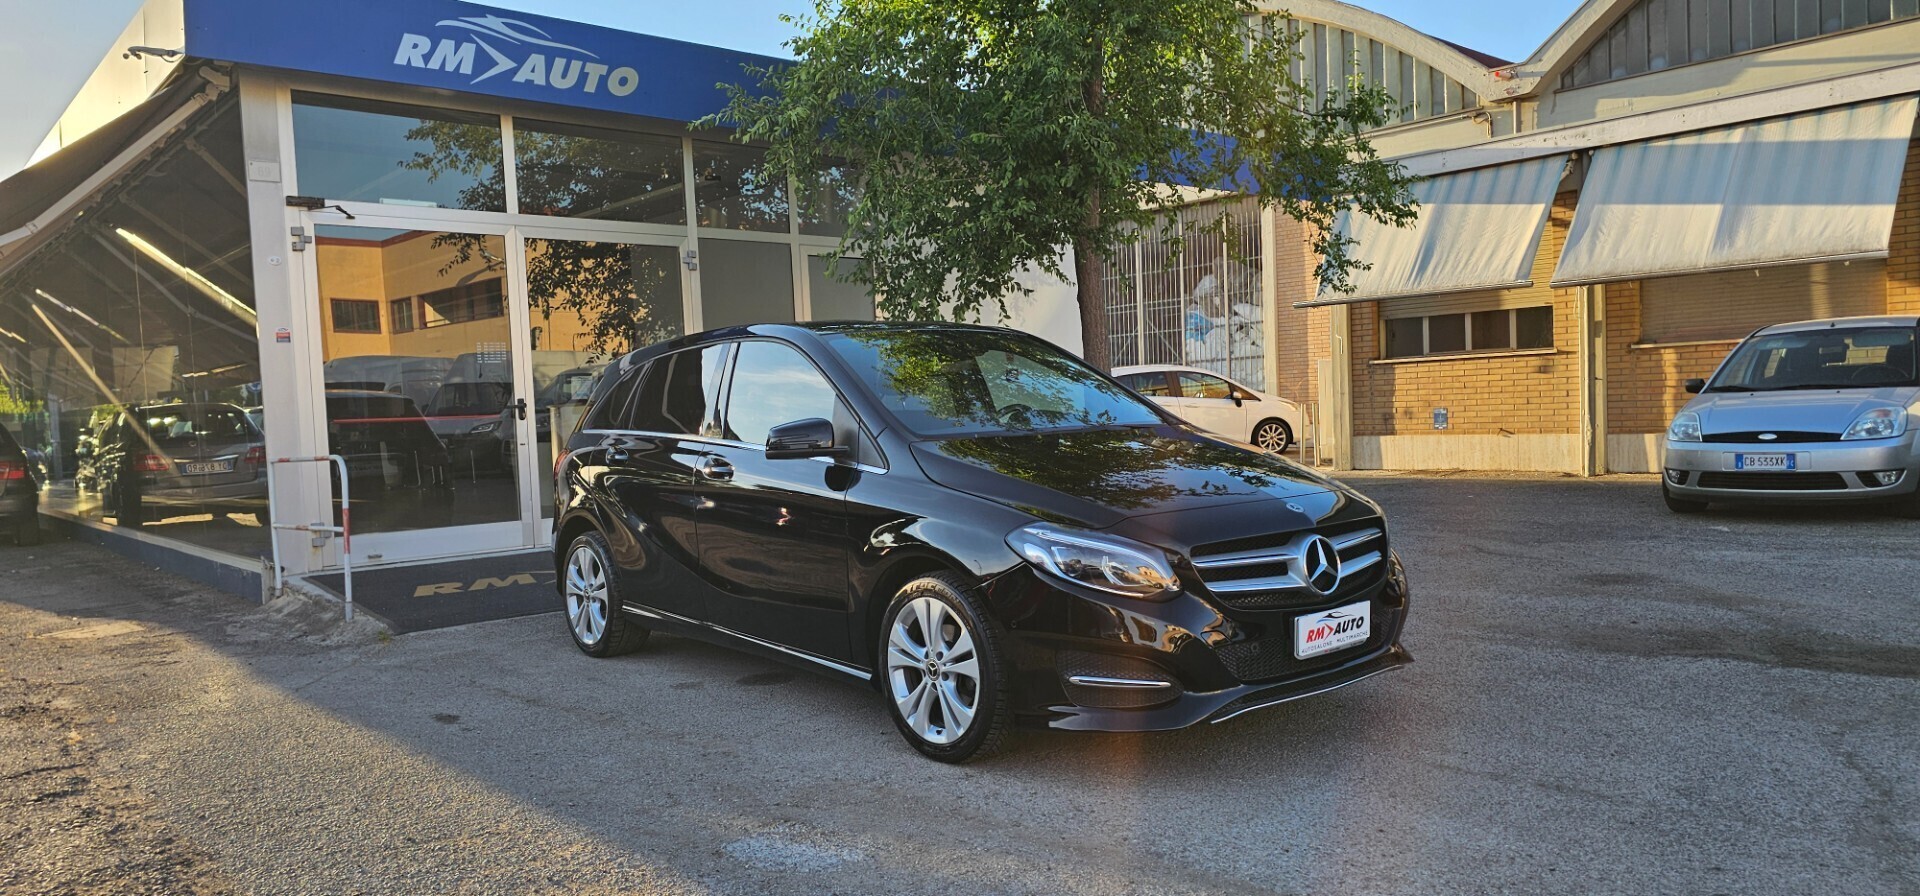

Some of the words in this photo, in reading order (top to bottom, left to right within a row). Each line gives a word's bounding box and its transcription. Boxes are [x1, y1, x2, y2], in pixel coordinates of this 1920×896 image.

[394, 33, 476, 74] RM
[512, 53, 639, 97] AUTO
[1744, 456, 1755, 467] CB
[413, 573, 537, 598] RM
[1301, 640, 1333, 653] AUTOSALONE
[1336, 630, 1368, 643] MULTIMARCHE
[1306, 626, 1326, 643] RM
[1333, 616, 1364, 635] AUTO
